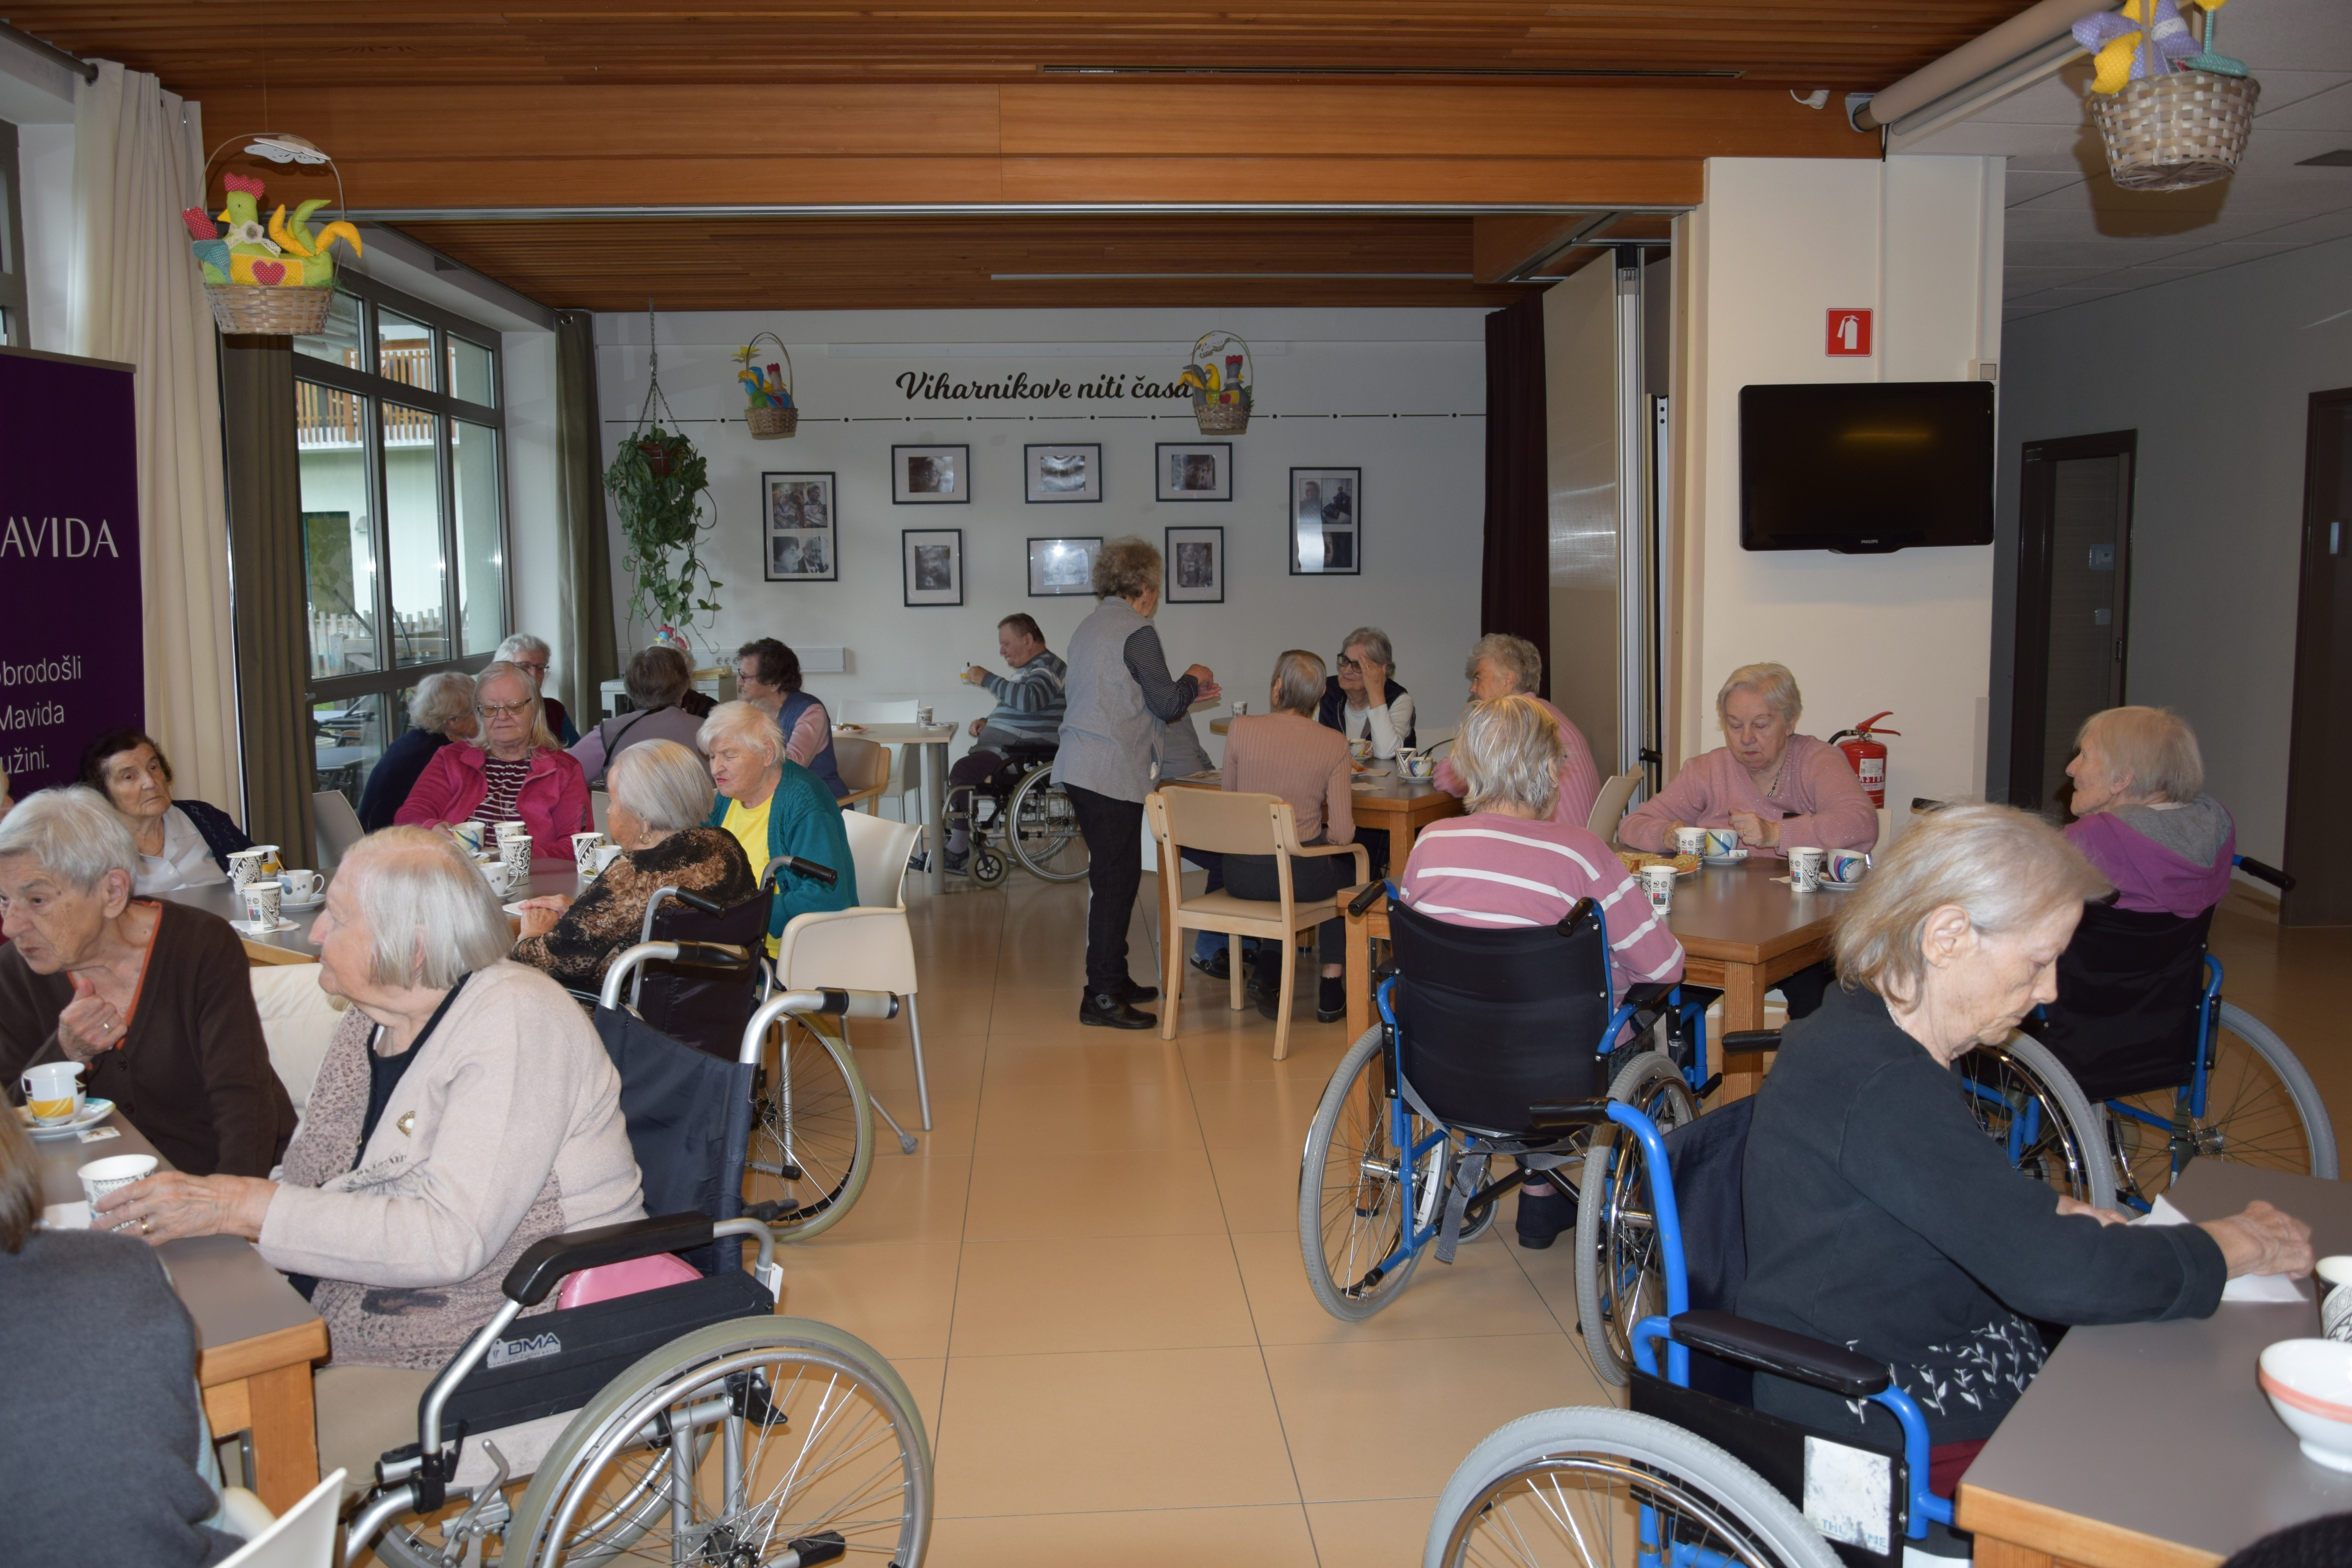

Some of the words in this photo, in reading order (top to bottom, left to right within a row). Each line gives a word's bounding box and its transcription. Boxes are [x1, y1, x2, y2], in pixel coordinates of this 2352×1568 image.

[896, 372, 1073, 399] Viharnikove
[1077, 374, 1125, 398] niti
[1131, 375, 1193, 398] časa
[0, 516, 119, 557] AVIDA
[0, 655, 81, 686] brodošli
[0, 701, 64, 730] Mavida
[508, 1334, 559, 1356] DMA
